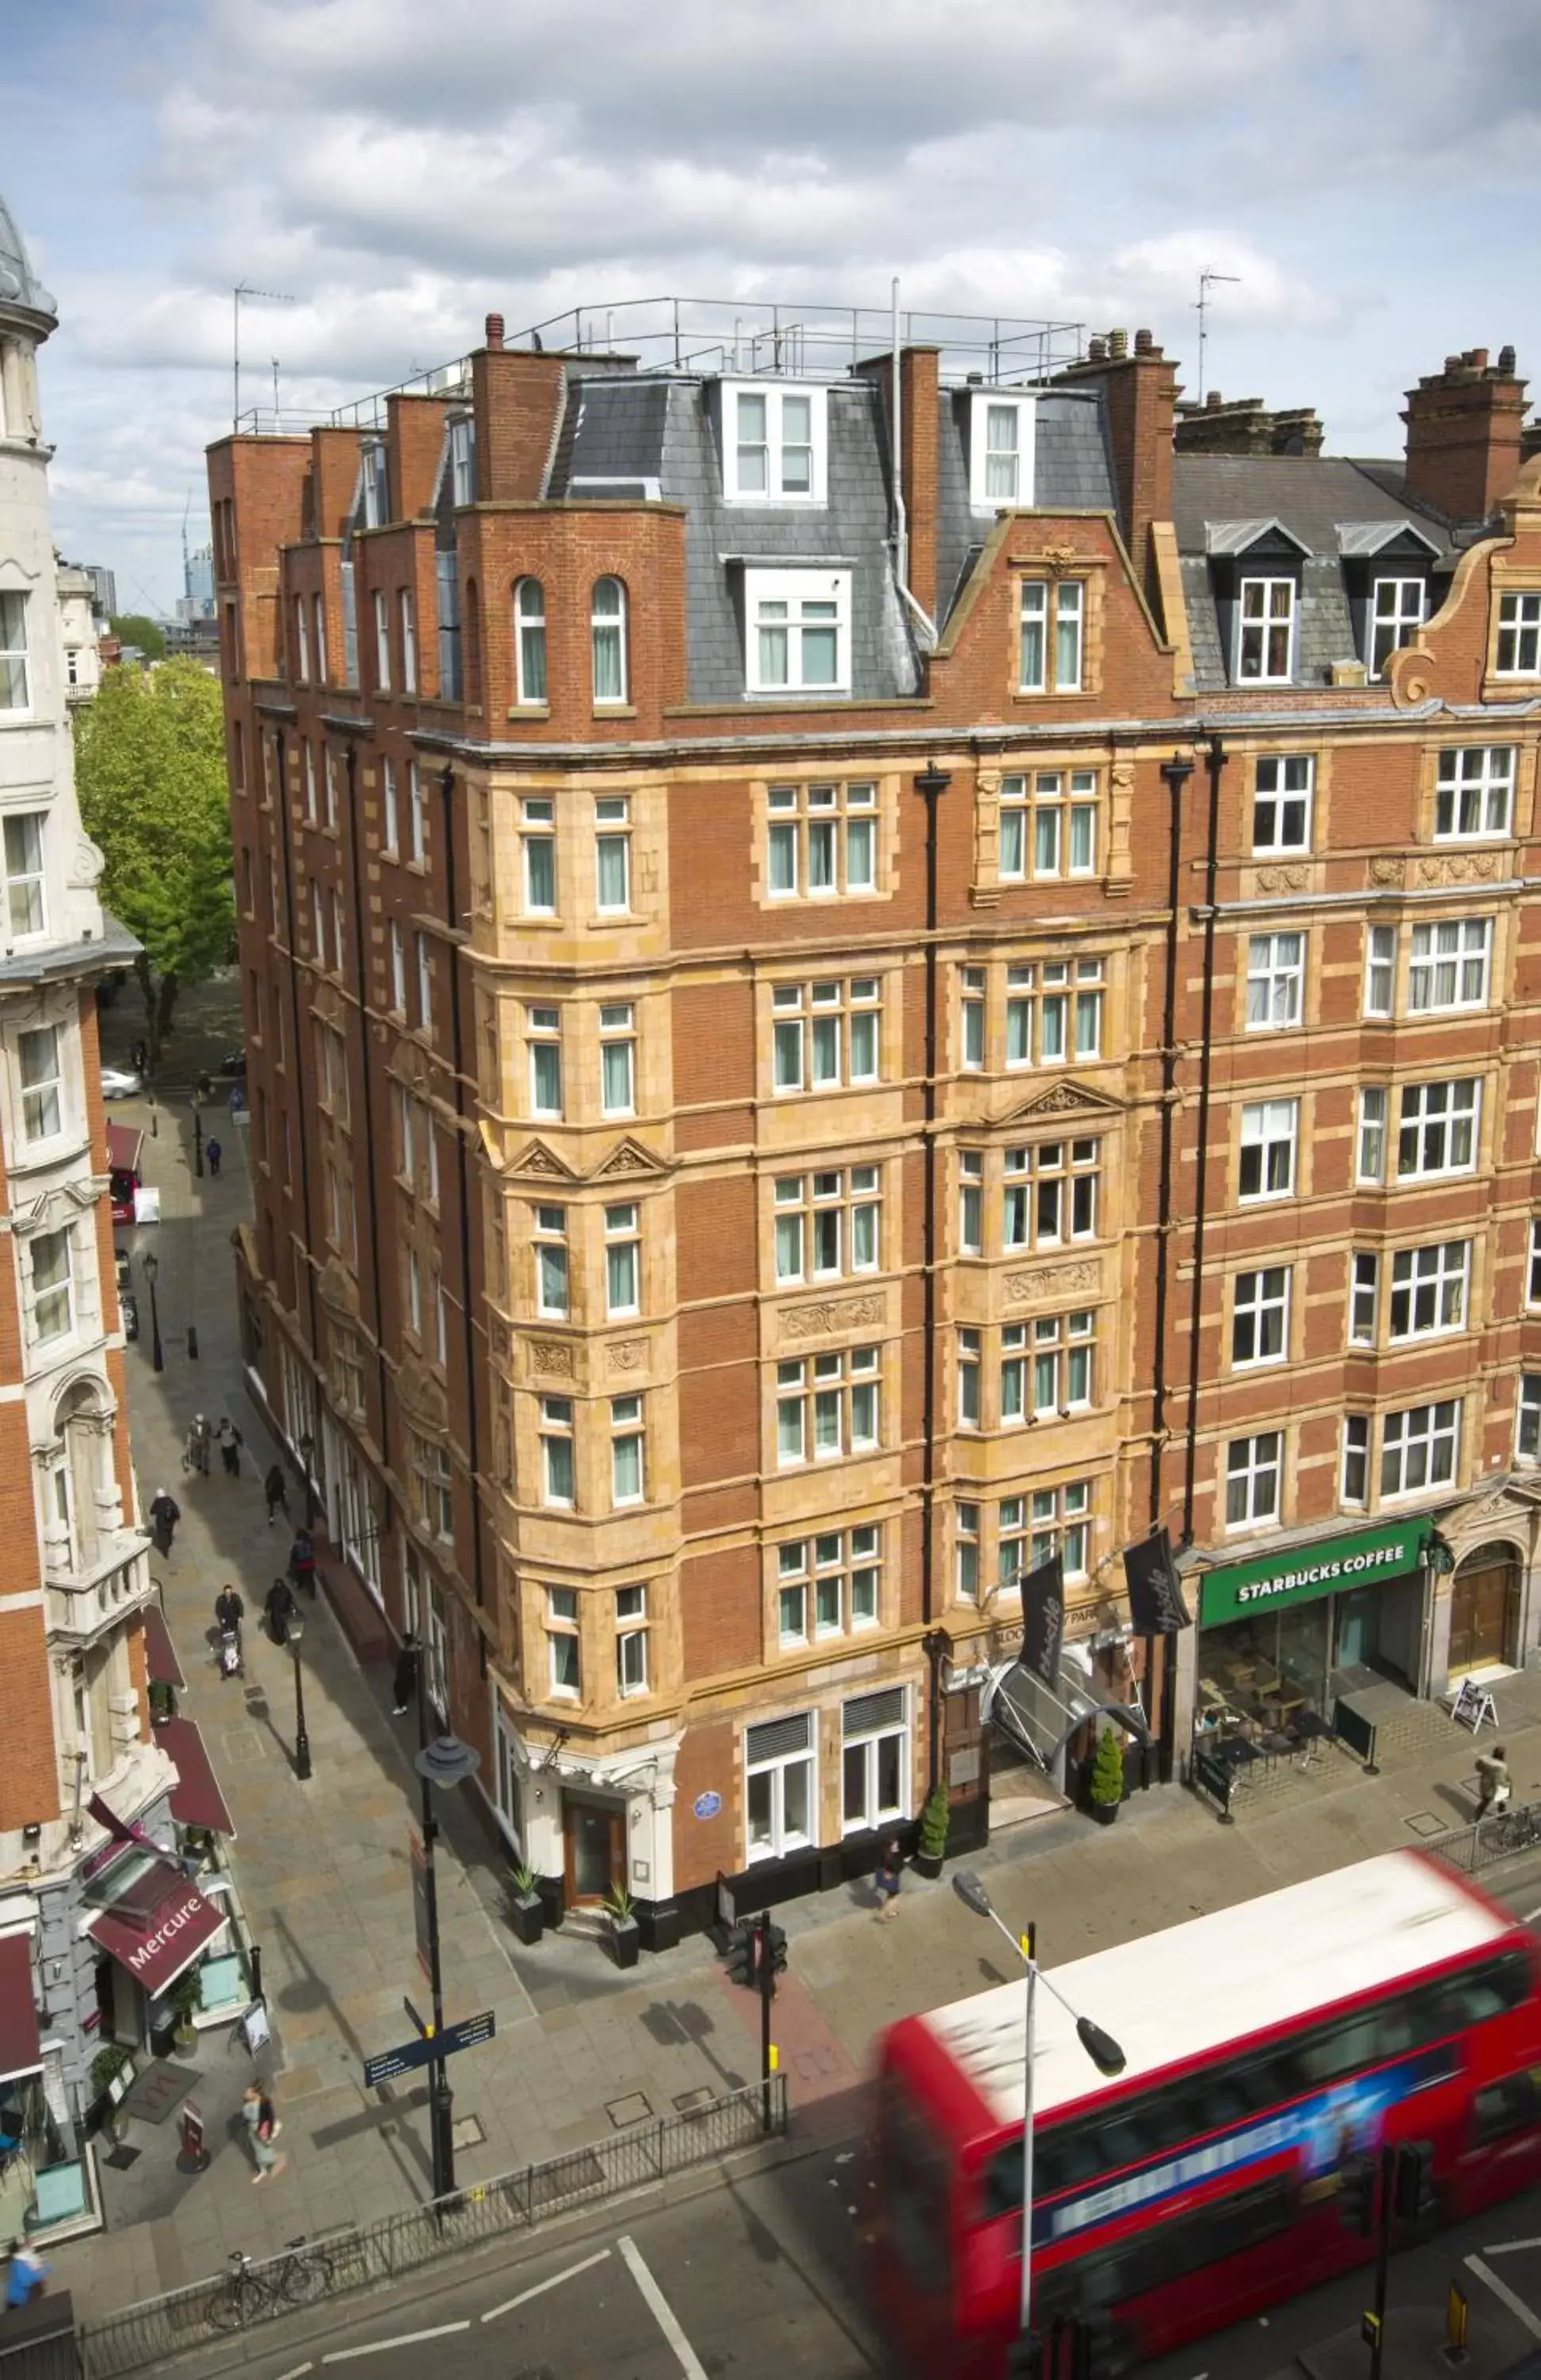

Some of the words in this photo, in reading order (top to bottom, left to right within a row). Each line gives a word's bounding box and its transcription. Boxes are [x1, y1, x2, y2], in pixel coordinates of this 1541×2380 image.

[1239, 1563, 1339, 1602] STARBUCKS
[1343, 1545, 1404, 1573] COFFEE
[129, 1898, 202, 1969] Mercure
